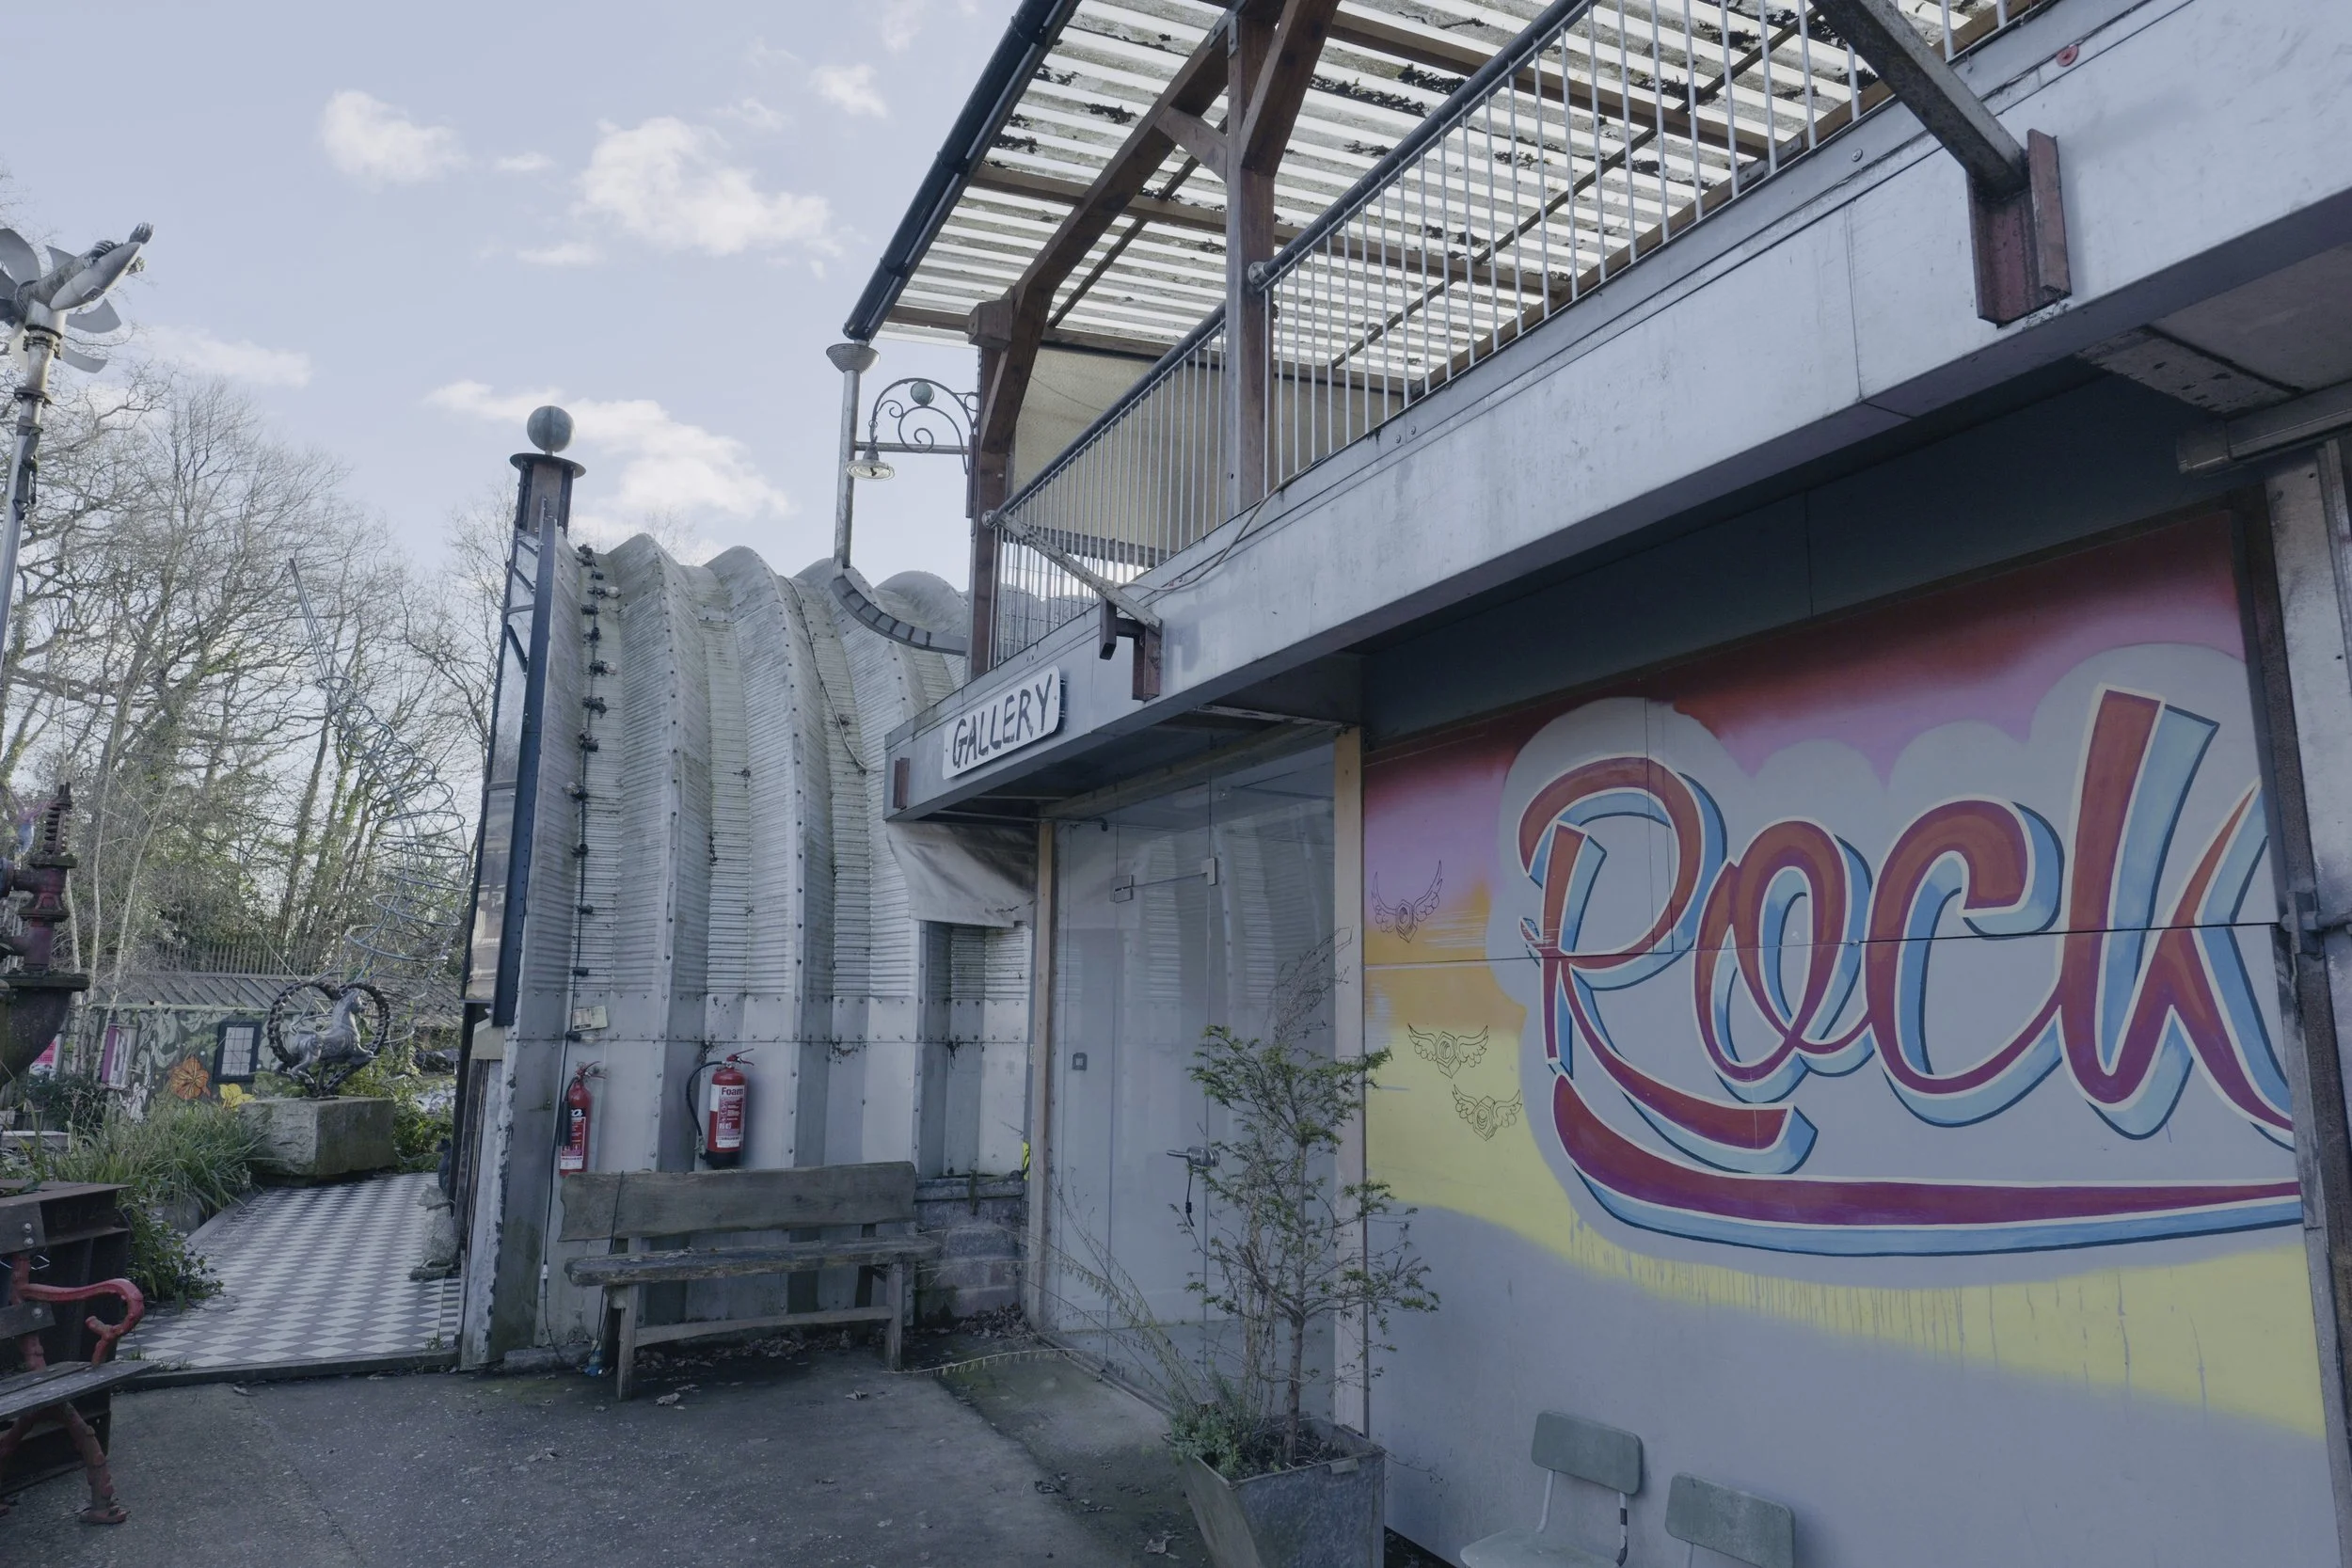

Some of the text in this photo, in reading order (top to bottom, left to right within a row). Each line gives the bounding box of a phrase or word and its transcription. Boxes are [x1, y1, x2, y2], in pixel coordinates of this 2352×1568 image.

[951, 673, 1053, 768] GALLERY
[1516, 683, 2297, 1176] Rock
[570, 1108, 583, 1117] O2
[721, 1086, 744, 1096] Foam
